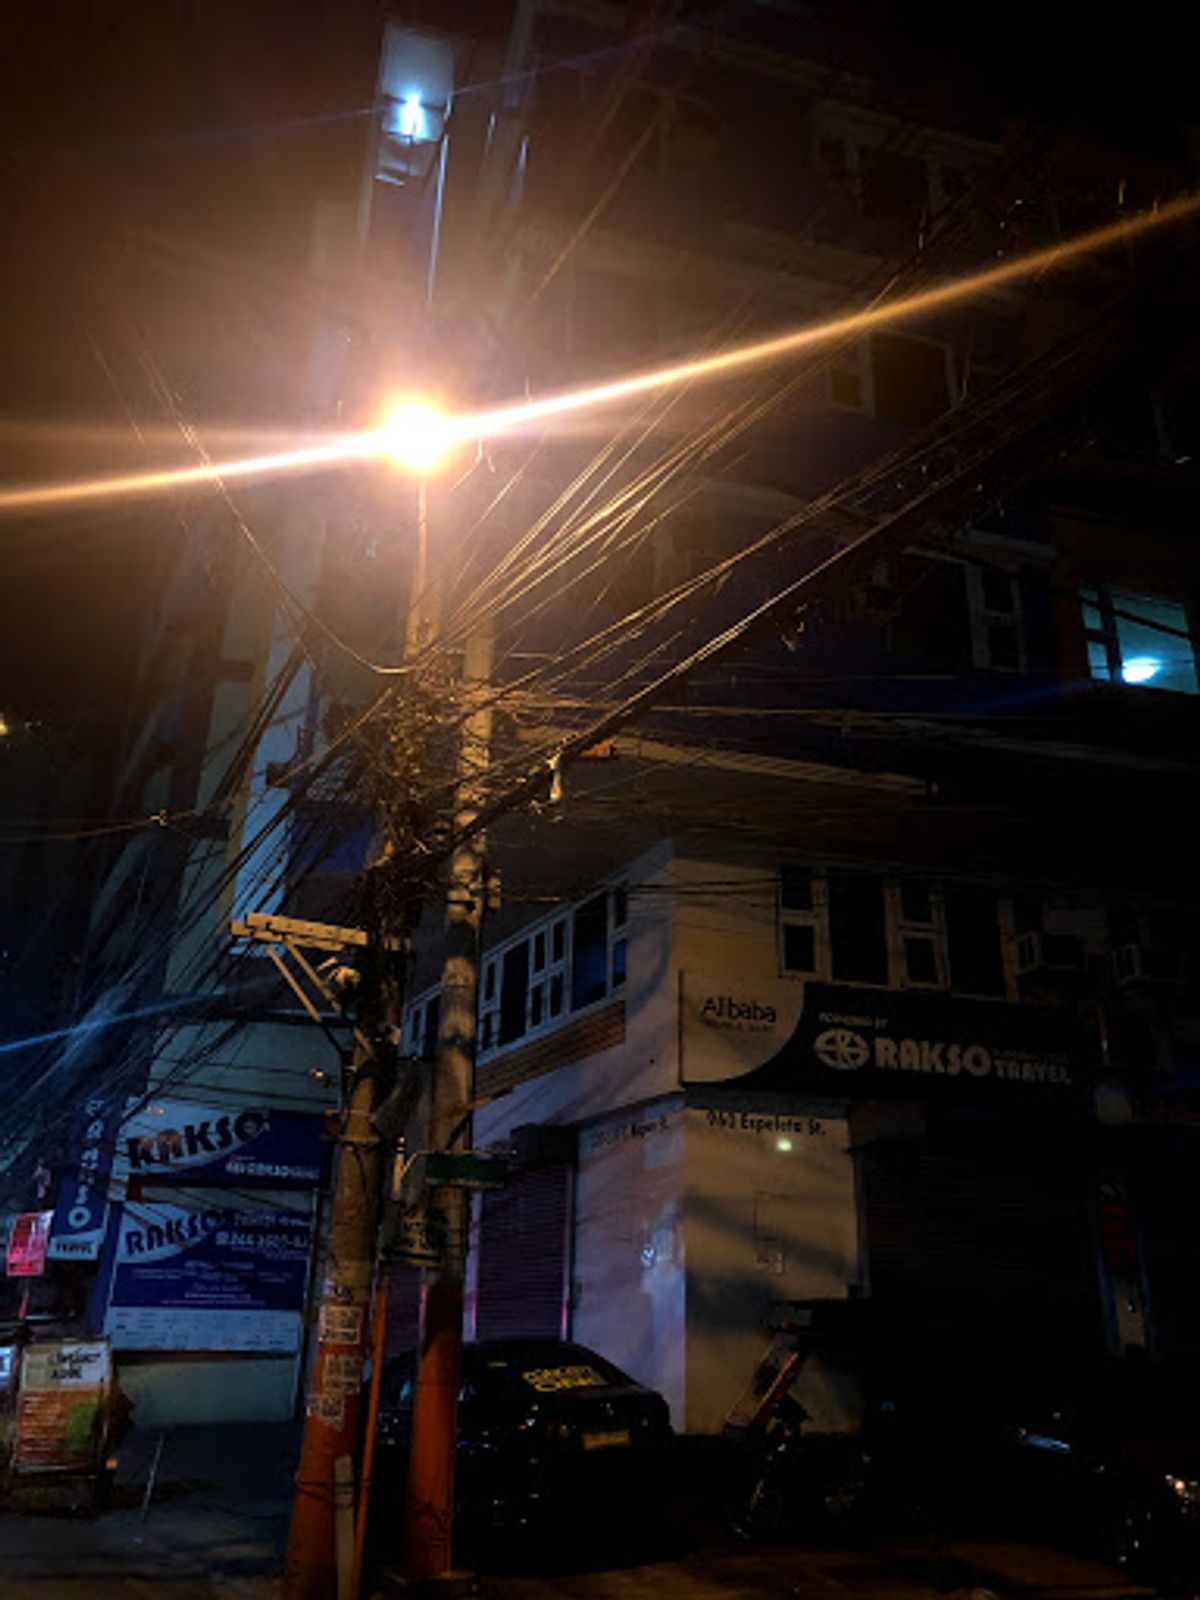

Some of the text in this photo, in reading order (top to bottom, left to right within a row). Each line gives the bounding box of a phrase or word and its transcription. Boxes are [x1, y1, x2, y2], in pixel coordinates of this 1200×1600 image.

[874, 1036, 992, 1078] RAKSO
[126, 1111, 264, 1169] RAKSO
[125, 1210, 220, 1257] RAKSO
